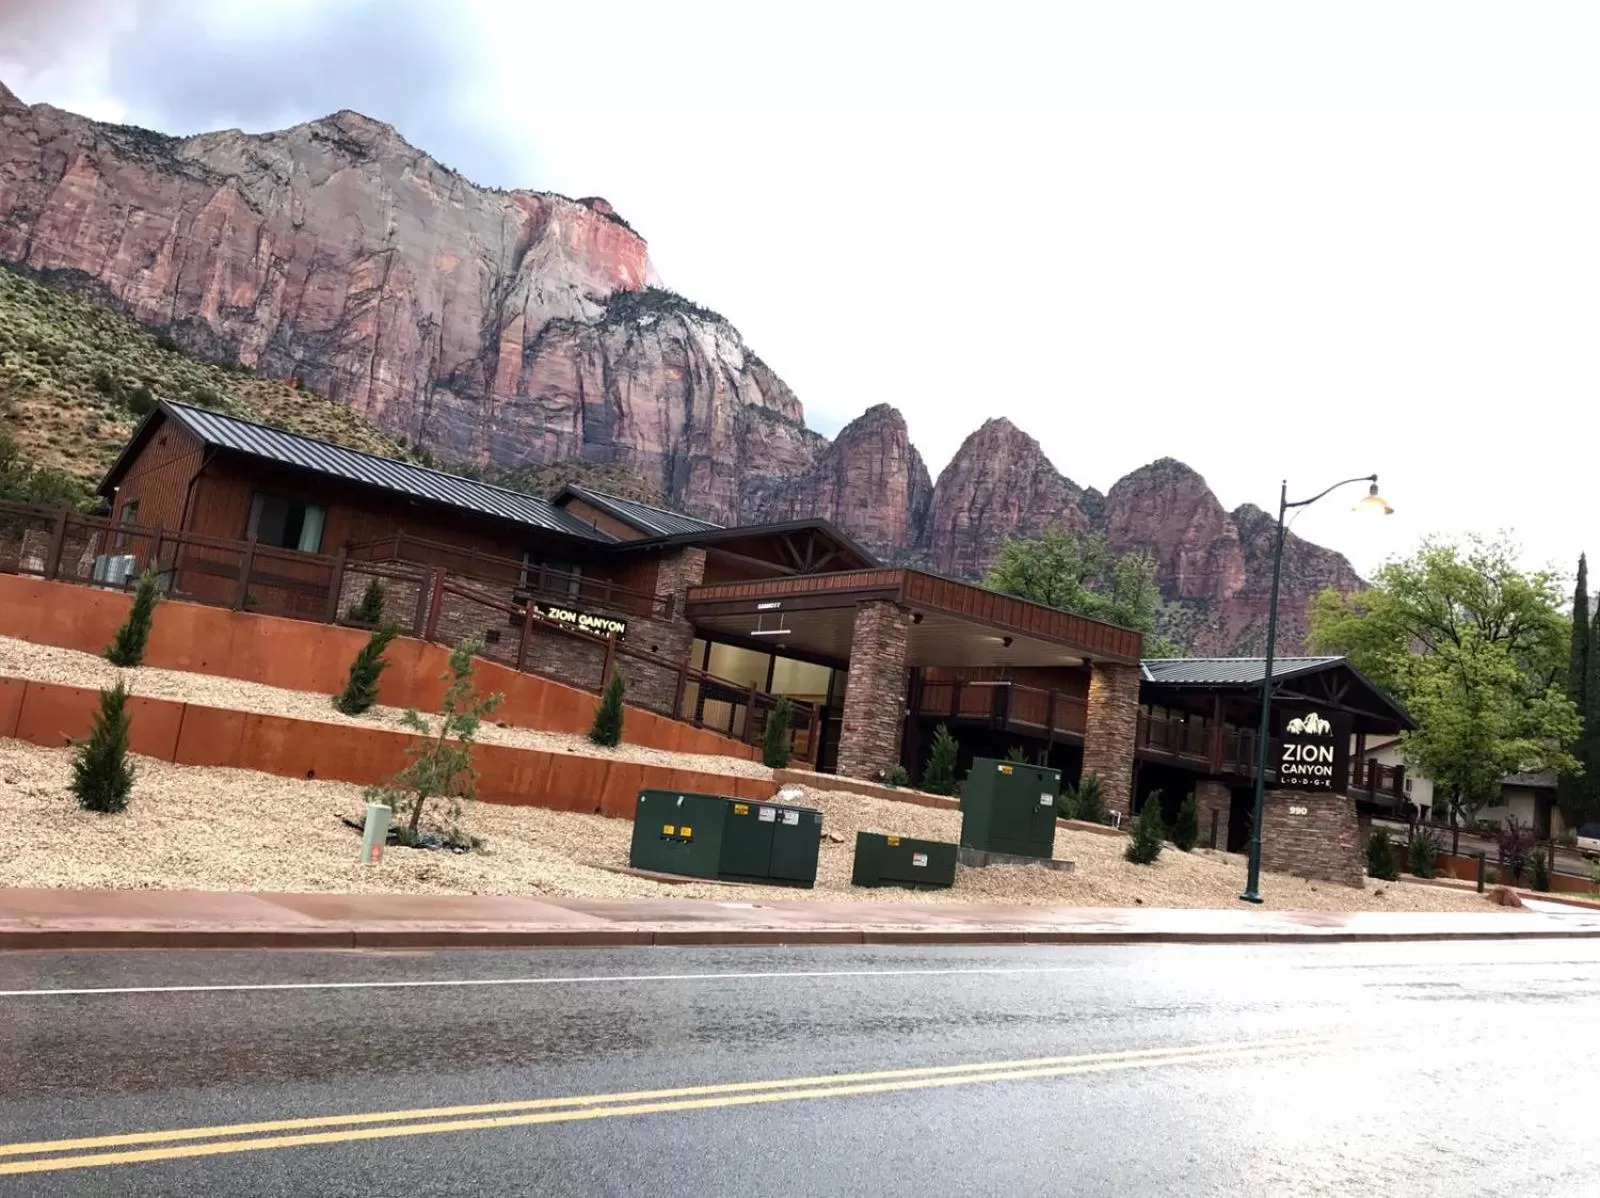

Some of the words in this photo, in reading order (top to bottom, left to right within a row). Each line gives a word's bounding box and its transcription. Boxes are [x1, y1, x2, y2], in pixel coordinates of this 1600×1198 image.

[548, 608, 576, 622] ZION
[579, 615, 625, 633] CANYON
[1282, 744, 1333, 762] ZION
[1281, 763, 1332, 775] CANYON
[1289, 806, 1307, 815] 990
